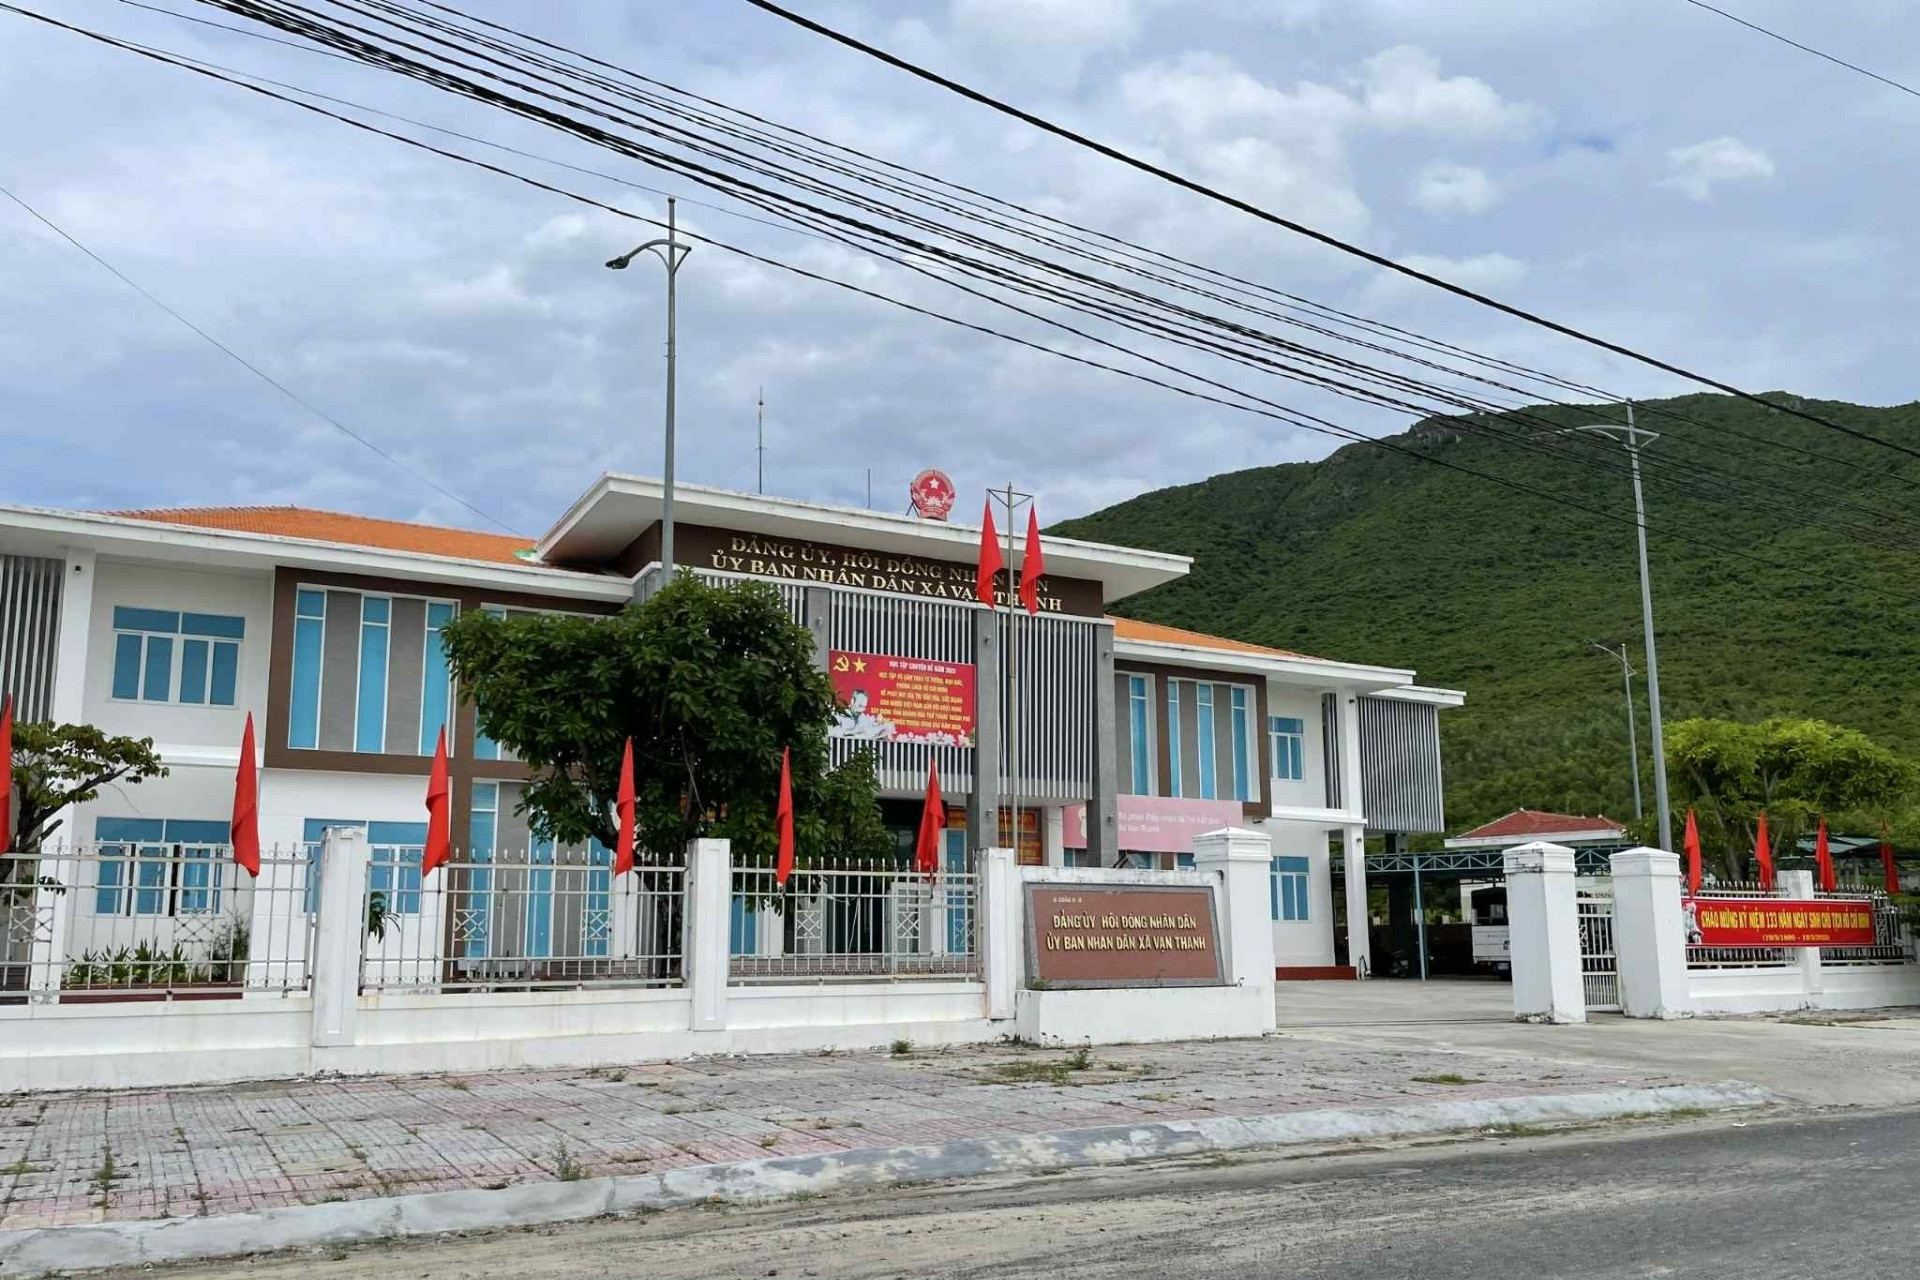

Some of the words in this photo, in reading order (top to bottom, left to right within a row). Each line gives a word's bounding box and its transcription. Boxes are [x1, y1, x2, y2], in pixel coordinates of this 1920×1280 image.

[731, 535, 795, 558] ĐẢNG
[801, 543, 836, 566] ỦY,
[886, 556, 941, 578] ĐỒNG
[949, 567, 1006, 586] NHN
[1012, 573, 1049, 592] DN
[712, 549, 745, 571] ỦY
[750, 560, 797, 578] BAN
[803, 568, 866, 587] NHÂN
[872, 575, 915, 593] DÂN
[920, 581, 947, 597] XÃ
[950, 585, 979, 602] VẠ
[994, 591, 1062, 611] THNH
[1053, 909, 1080, 928] ĐẢNG
[1149, 913, 1176, 929] NHÂN
[1177, 913, 1197, 929] DÂN
[1766, 911, 1778, 928] 133
[1064, 935, 1085, 950] BAN
[1116, 933, 1136, 950] DÂN
[1153, 936, 1172, 953] VẠN
